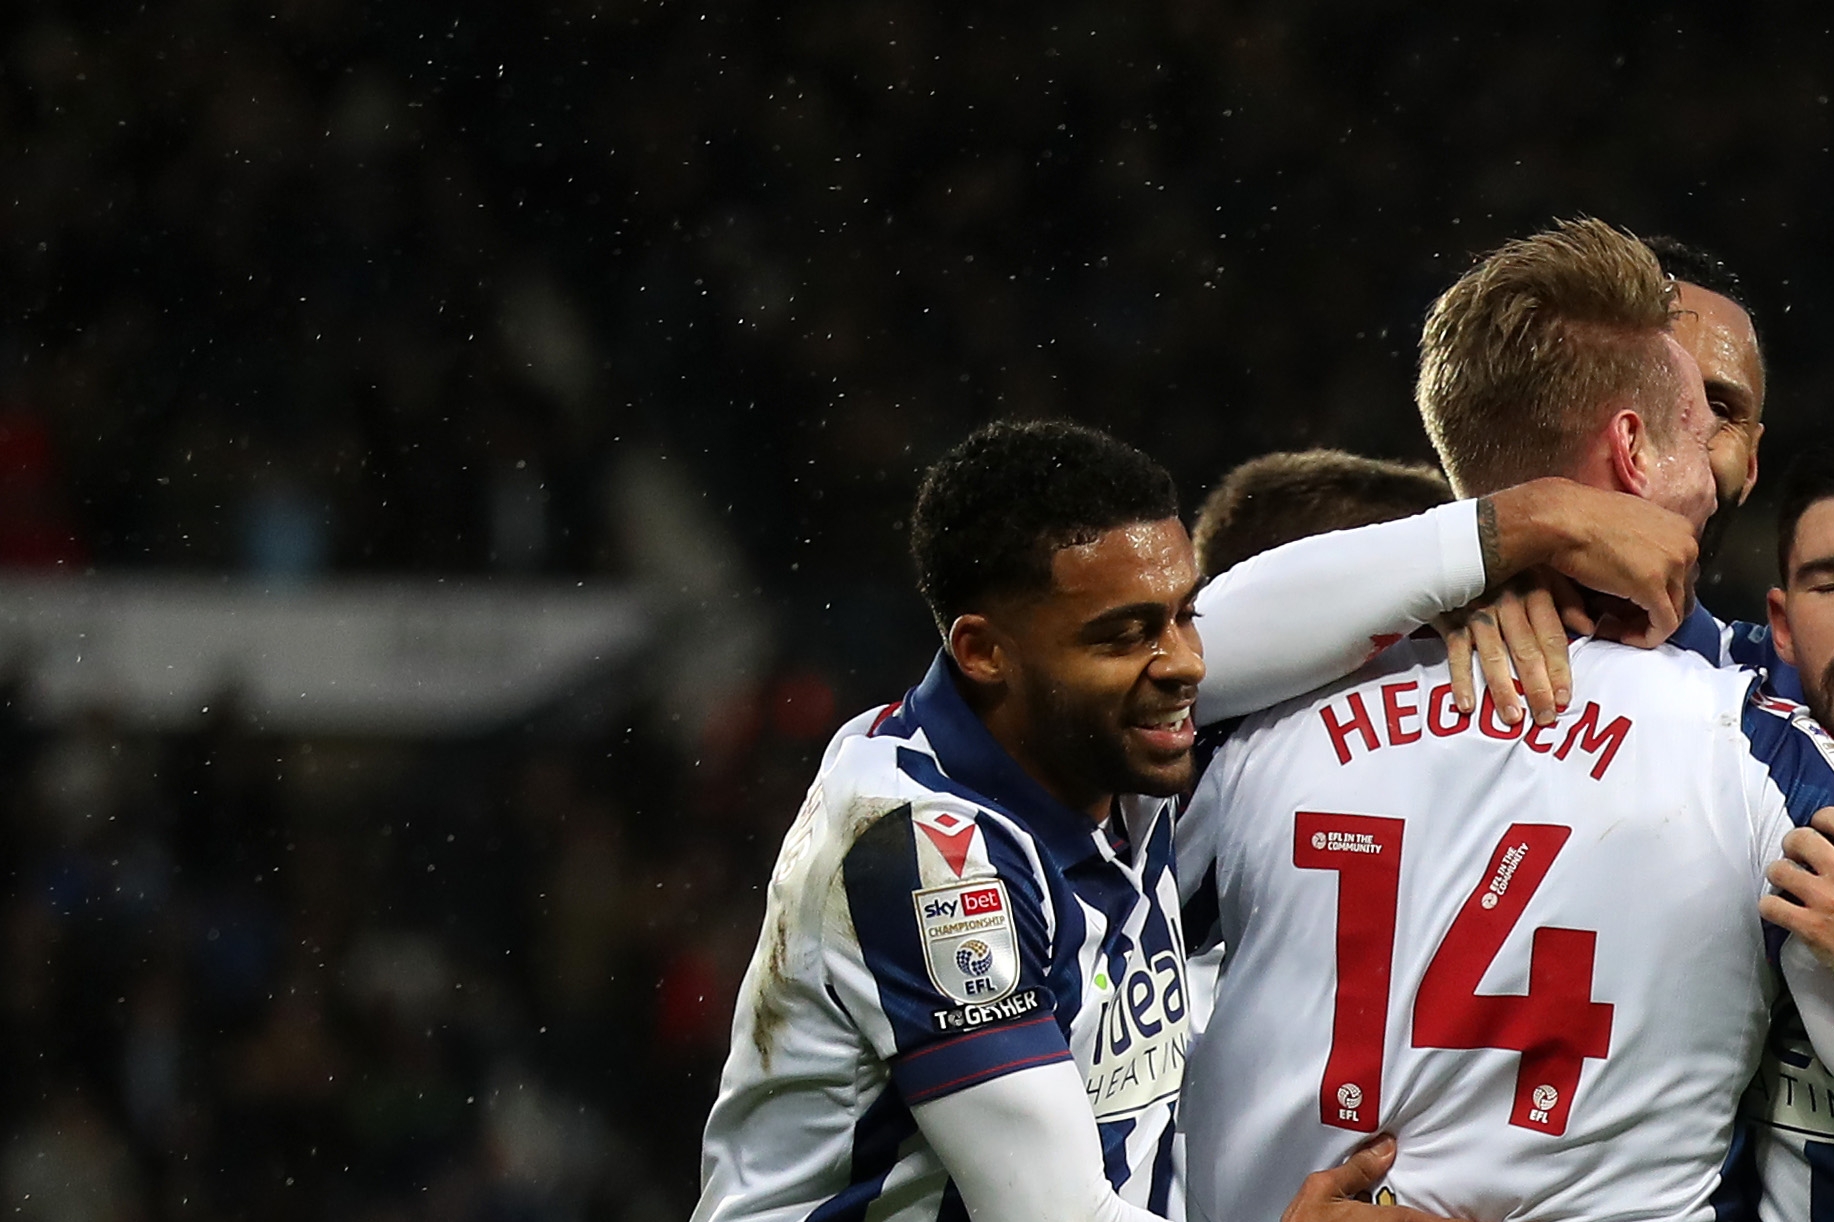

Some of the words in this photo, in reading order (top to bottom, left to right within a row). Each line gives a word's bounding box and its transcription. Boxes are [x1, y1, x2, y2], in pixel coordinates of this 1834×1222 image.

[1328, 832, 1342, 841] EFL
[1344, 833, 1355, 842] IN
[1356, 834, 1373, 844] THE
[1328, 842, 1382, 854] COMMUNITY
[1497, 842, 1529, 896] COMMUNITY
[924, 899, 958, 918] sky
[965, 891, 998, 910] bet
[928, 916, 1005, 938] CHAMPIONSHIP
[1293, 811, 1615, 1137] 14
[964, 978, 998, 995] EFL
[1339, 1109, 1359, 1122] EFL
[1529, 1109, 1549, 1124] EFL
